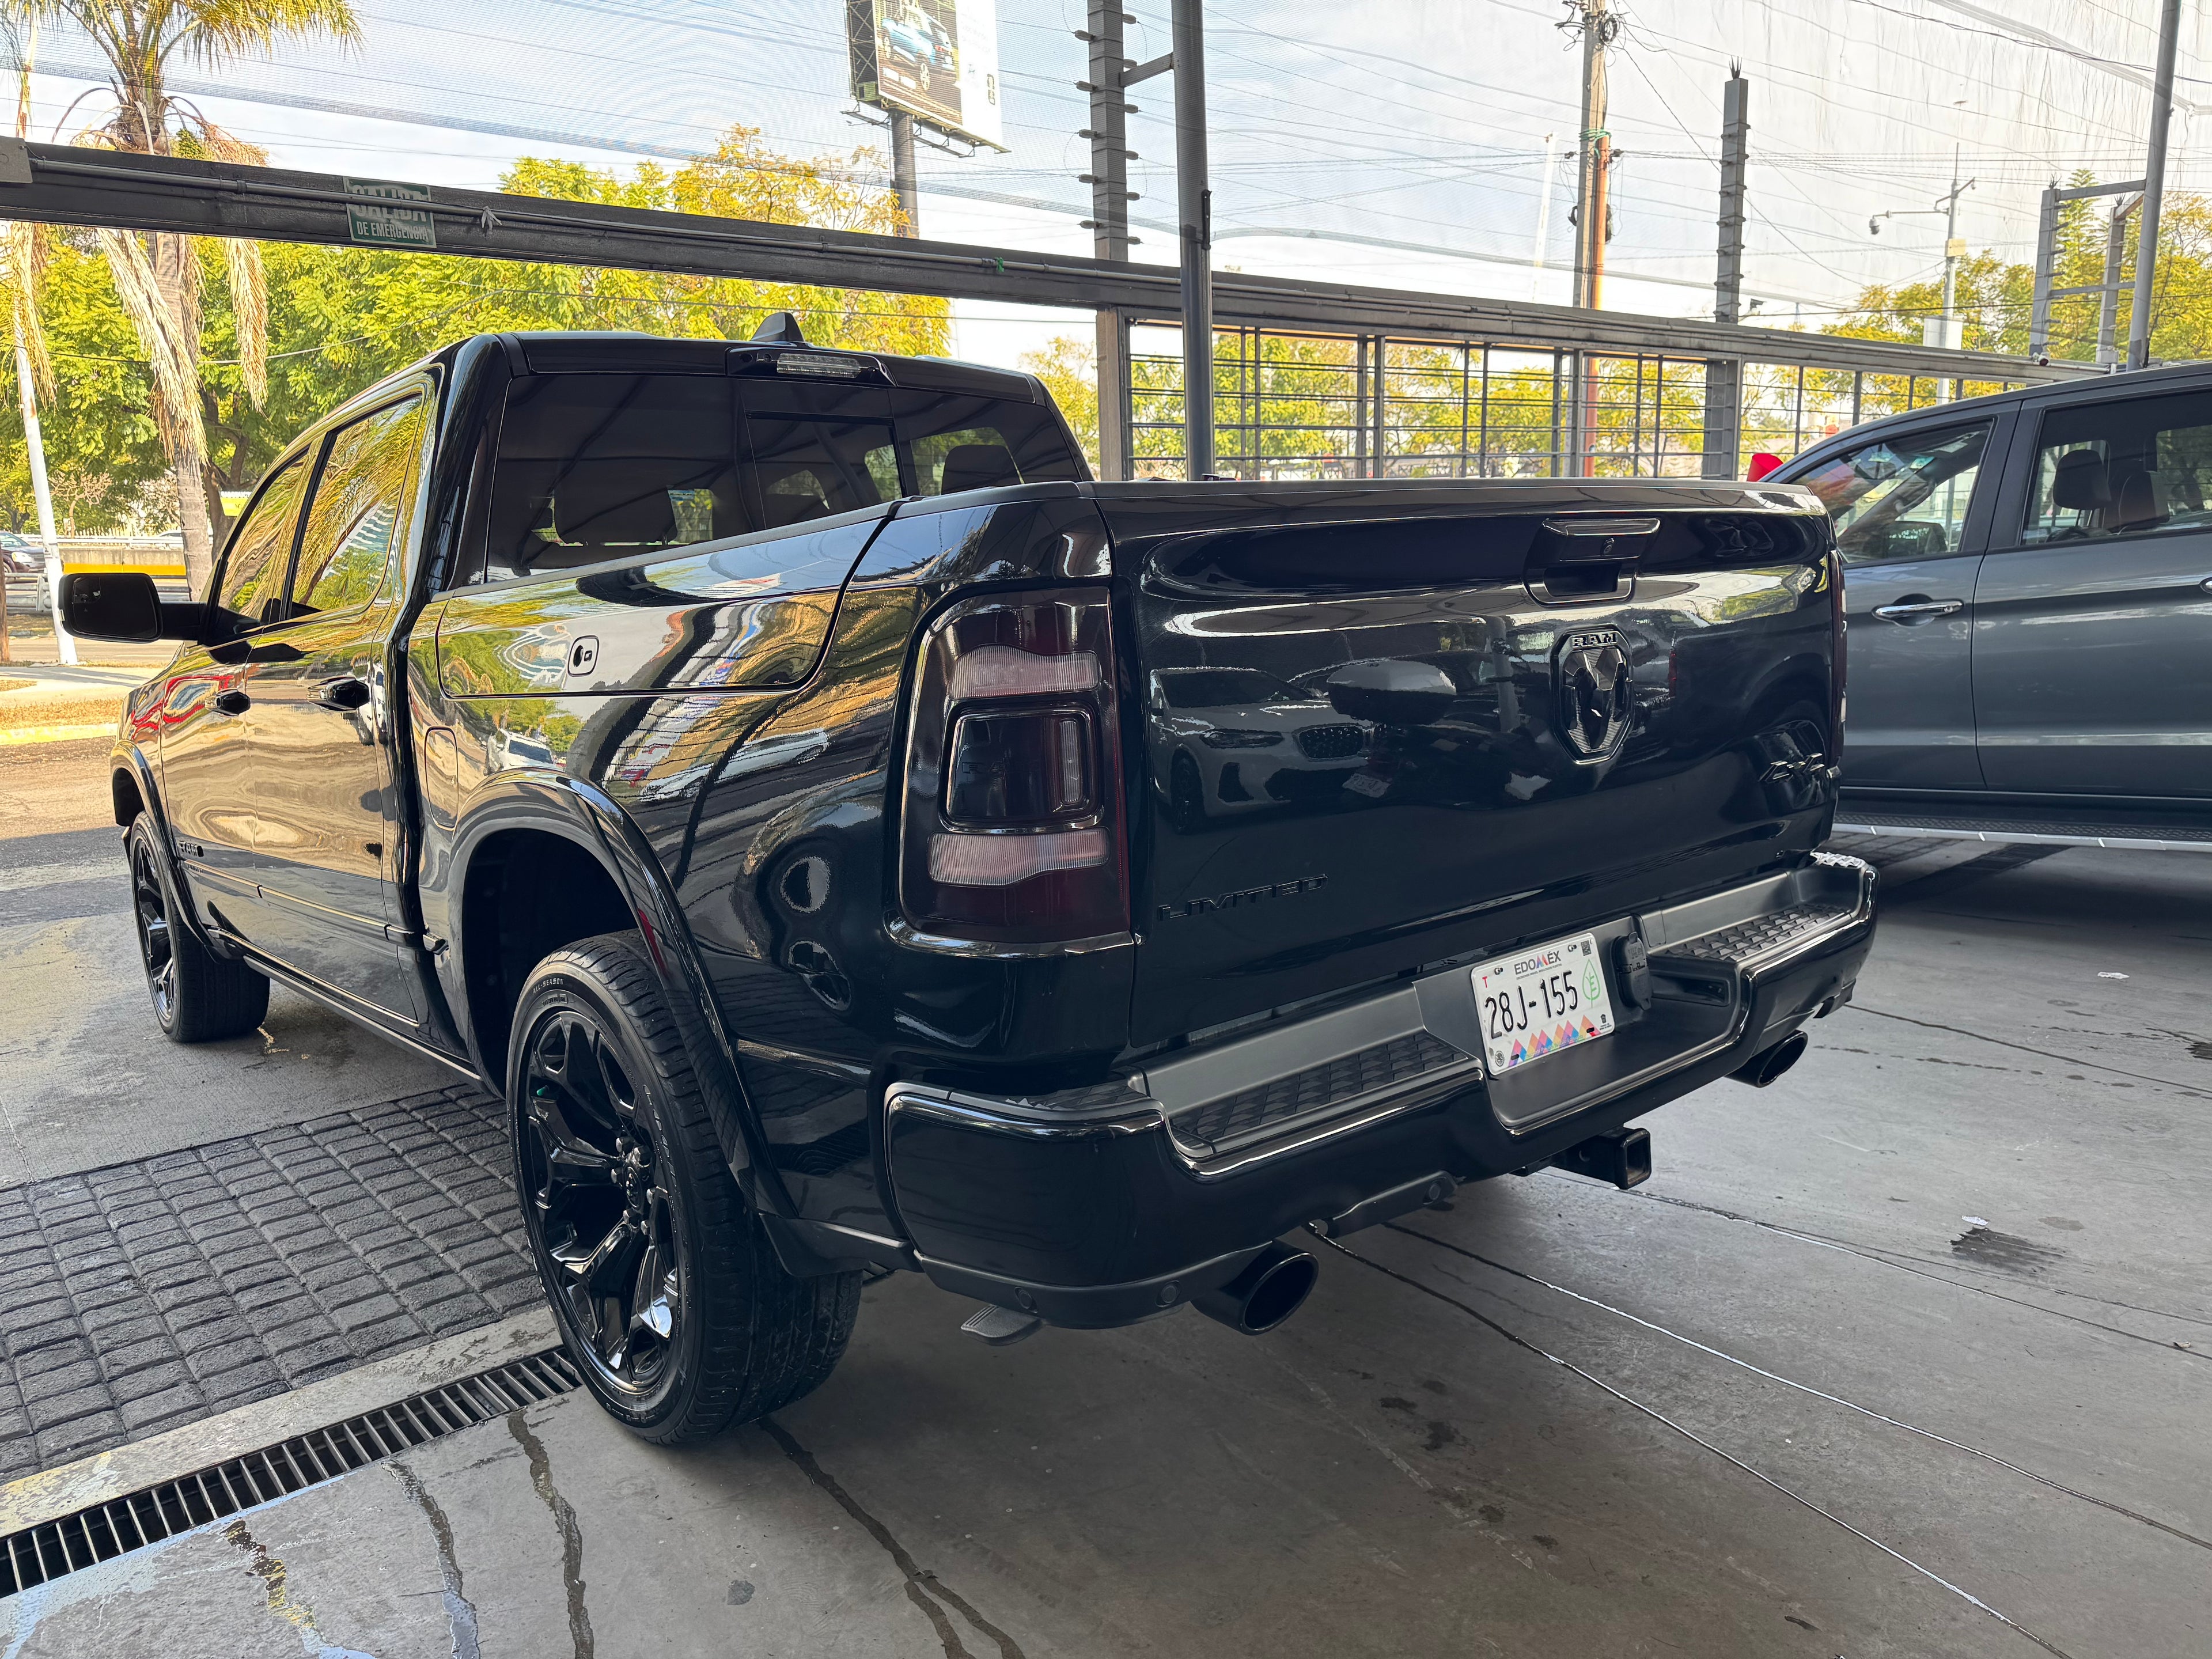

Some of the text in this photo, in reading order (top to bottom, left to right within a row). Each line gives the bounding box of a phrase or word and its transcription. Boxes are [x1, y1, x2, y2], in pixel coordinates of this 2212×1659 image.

[356, 221, 429, 241] DE EMERGENCIA
[1572, 633, 1618, 649] RAM
[179, 840, 204, 857] RAM
[1158, 873, 1328, 921] LIMITED
[1514, 950, 1562, 975] EDOMÉX
[532, 978, 564, 994] ALL-SEASON
[1482, 976, 1488, 988] T
[1484, 970, 1578, 1040] 28J-155
